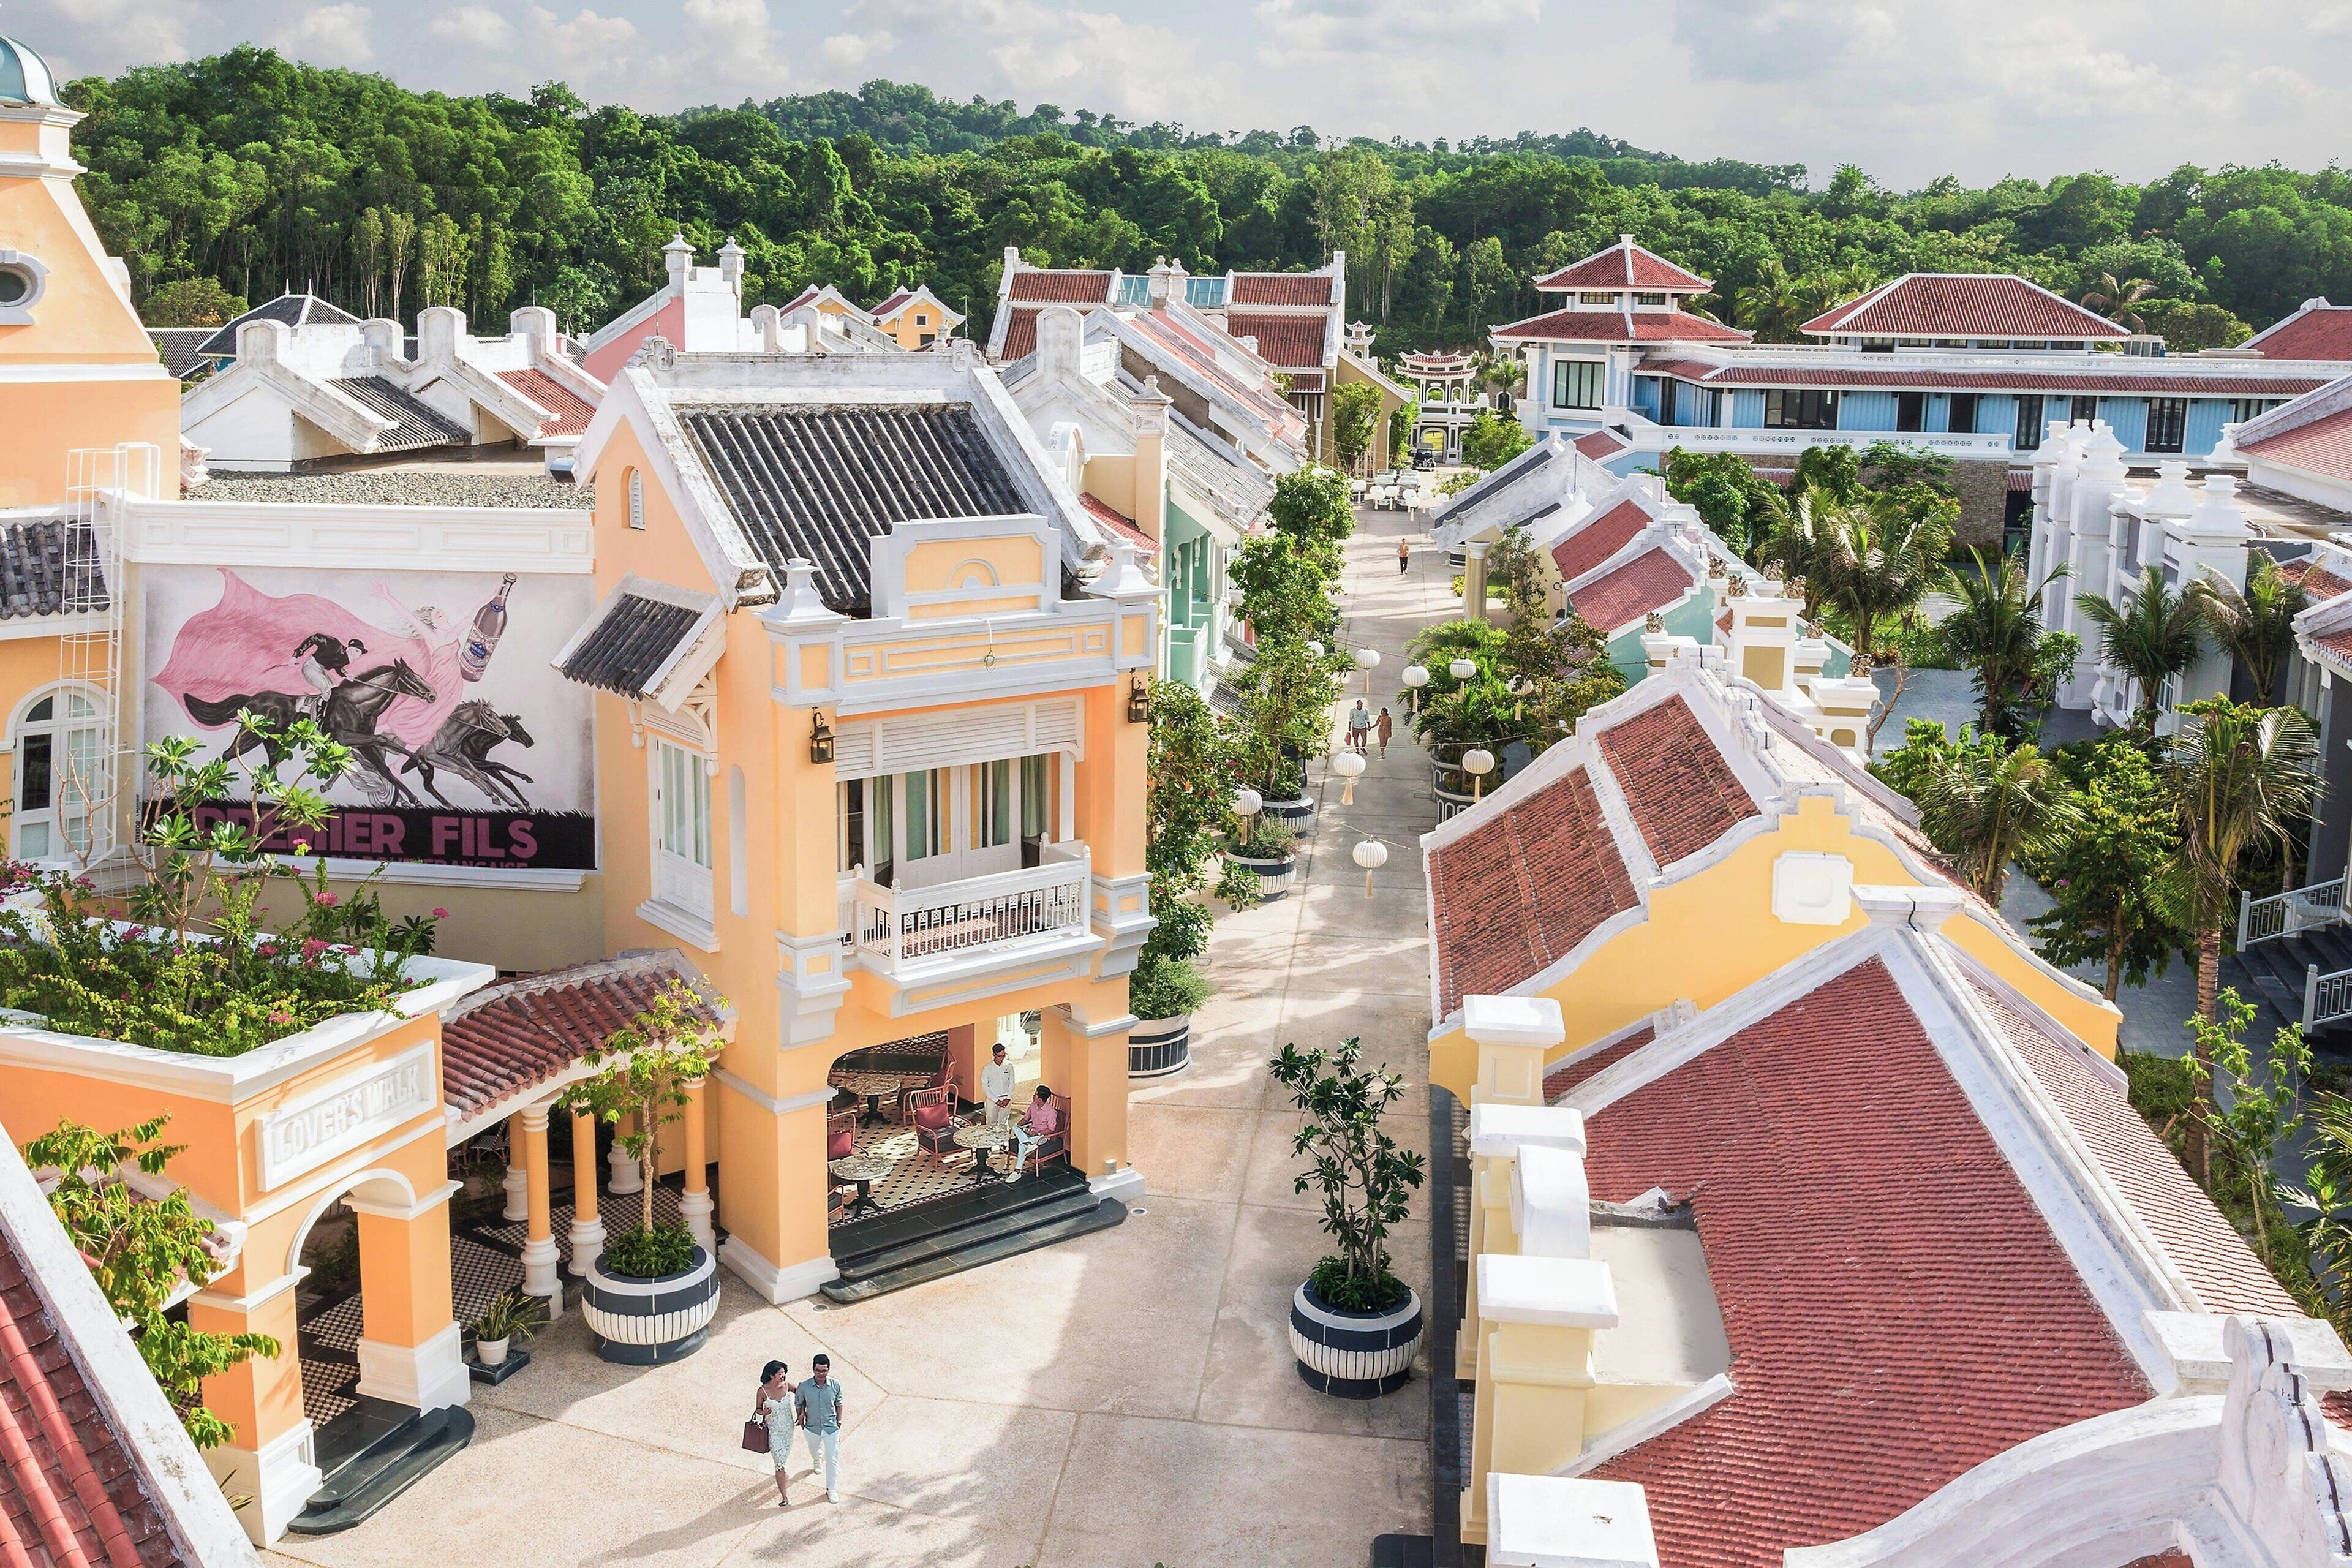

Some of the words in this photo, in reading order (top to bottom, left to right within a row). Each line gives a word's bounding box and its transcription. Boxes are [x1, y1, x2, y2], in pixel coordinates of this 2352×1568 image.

[432, 816, 538, 858] FILS
[274, 1088, 363, 1163] LOVER'S
[362, 1064, 420, 1120] WALK
